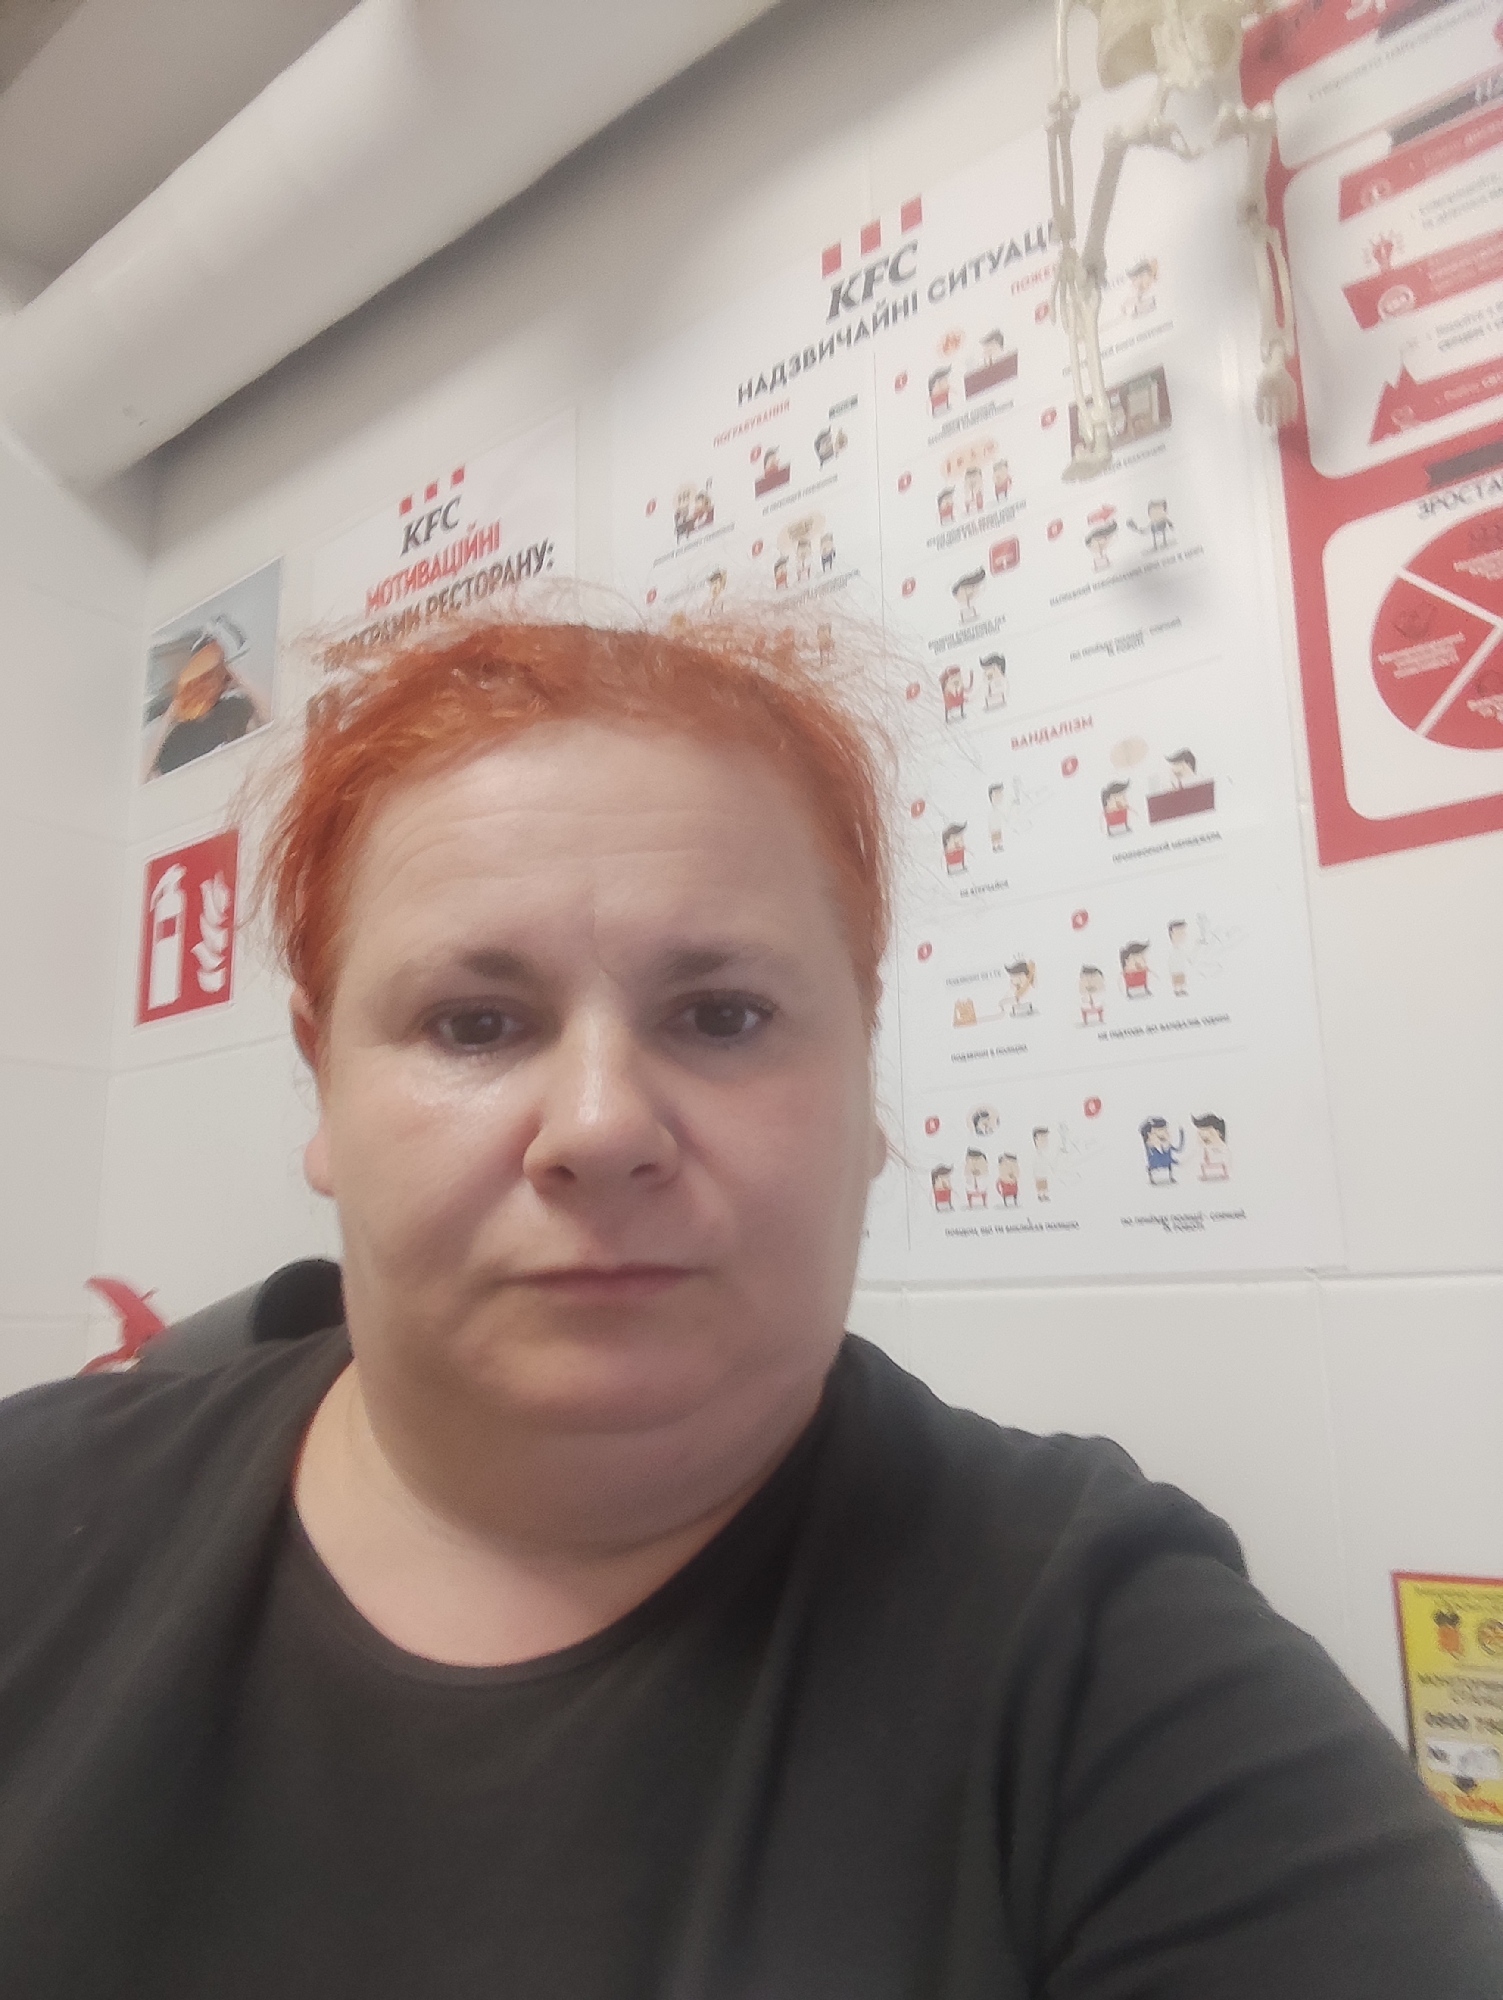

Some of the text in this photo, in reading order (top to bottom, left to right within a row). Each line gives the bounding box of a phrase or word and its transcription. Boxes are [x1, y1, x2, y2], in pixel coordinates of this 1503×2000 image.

[737, 217, 1054, 407] НАДЗВИЧАЙНІ СИТУАЦІ
[826, 239, 918, 323] KFC
[1010, 264, 1053, 296] ПОЖЕ
[713, 400, 790, 448] ПОГРАБУВАННЯ
[400, 494, 462, 557] KFC
[365, 516, 501, 618] МОТИВАЦІЙНІ
[425, 538, 555, 624] РЕСТОРАНУ:
[1010, 715, 1095, 750] ВАНДАЛІЗМ
